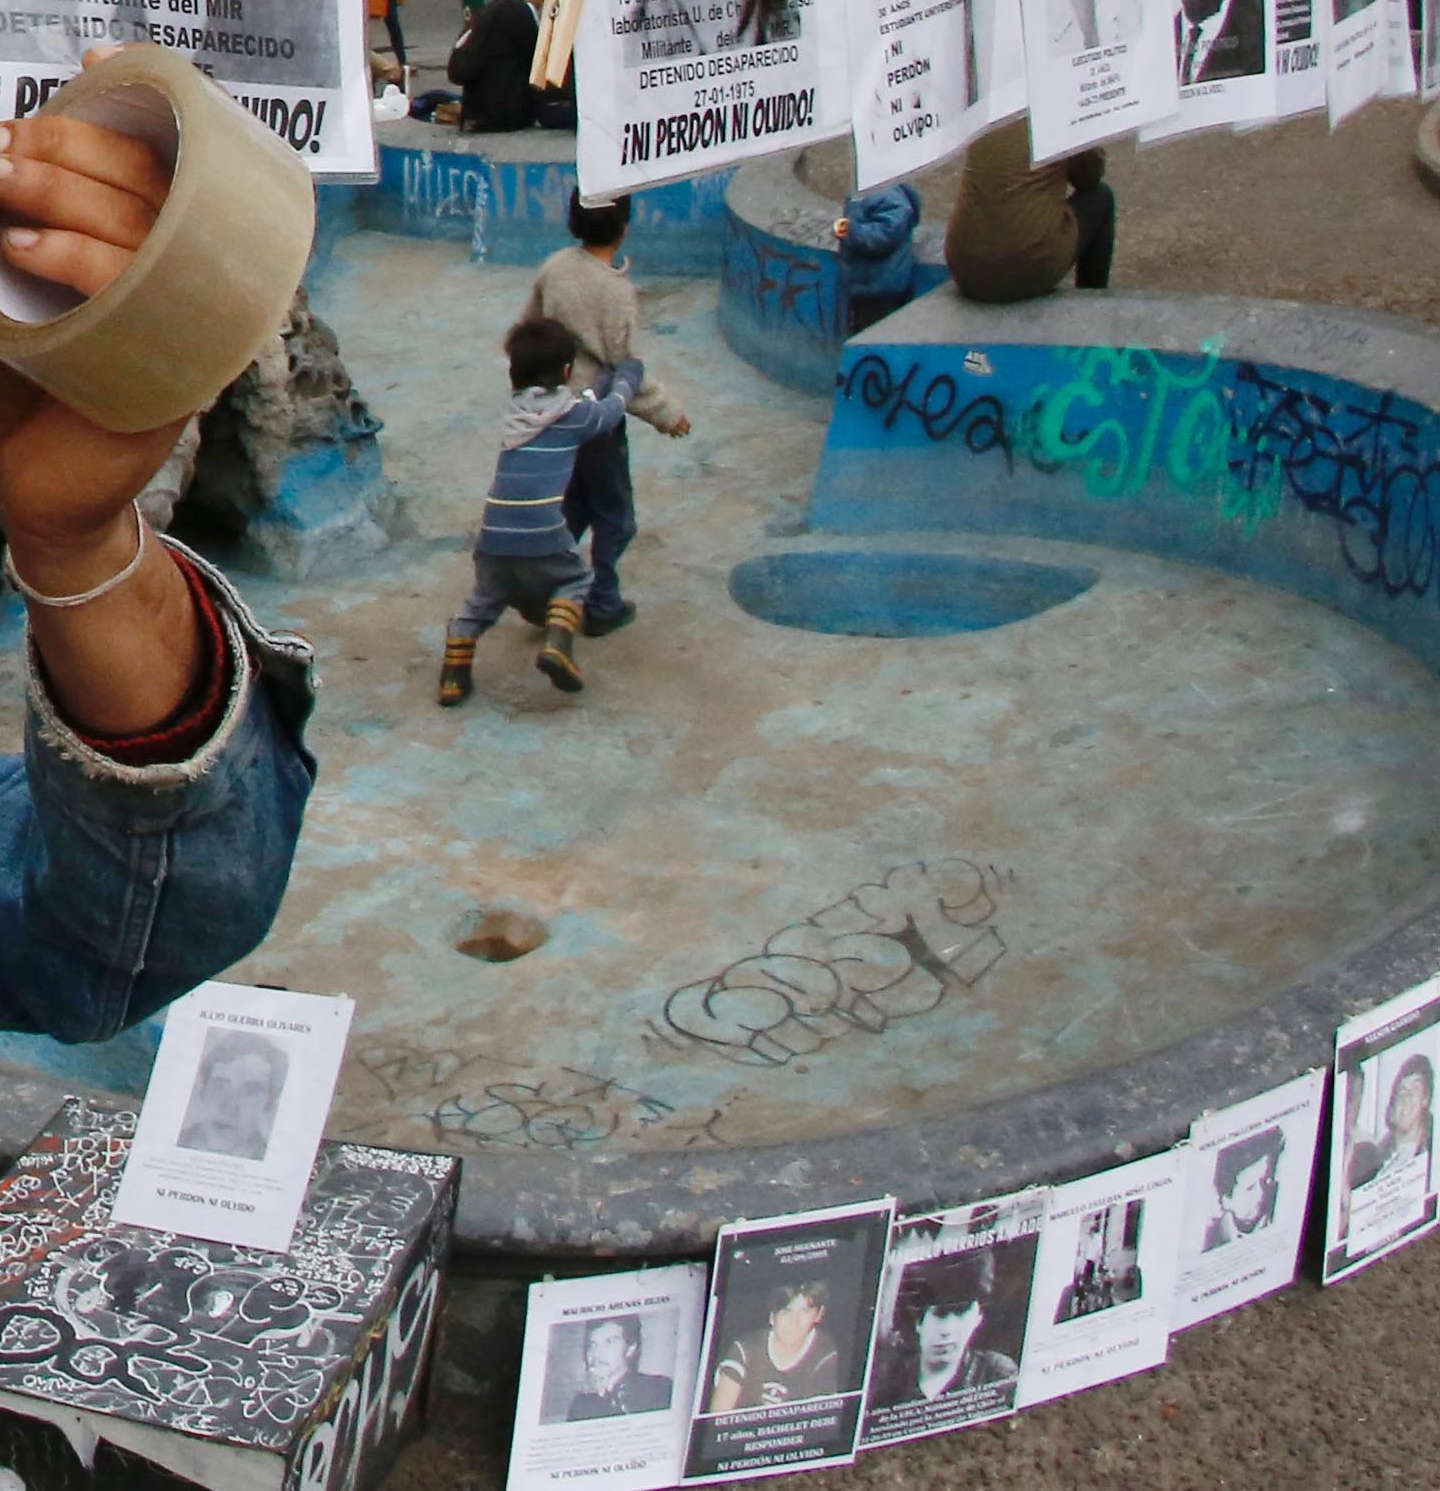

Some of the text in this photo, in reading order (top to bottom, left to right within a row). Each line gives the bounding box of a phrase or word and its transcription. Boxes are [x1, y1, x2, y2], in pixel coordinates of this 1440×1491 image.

[611, 12, 691, 36] laboratorista
[709, 4, 724, 22] de
[879, 11, 924, 36] ESTUDIANTE
[133, 21, 295, 60] DESAPARECIDO
[641, 38, 693, 61] Militante
[890, 40, 904, 58] NI
[640, 45, 800, 90] DETENIDO DESAPARECIDO
[694, 80, 755, 109] 27-01-1975
[889, 97, 903, 115] NI
[621, 88, 816, 167] ¡NI PERDON NI OLVIDO!
[893, 112, 933, 143] OLVIDO
[715, 1399, 844, 1426] DETENIDO DESAPARECIDO
[716, 1432, 727, 1443] 17
[757, 1420, 810, 1436] BACHELET
[811, 1415, 838, 1428] DEBE
[744, 1434, 803, 1451] RESPONDER
[717, 1447, 824, 1471] NI NI OLVIDO
